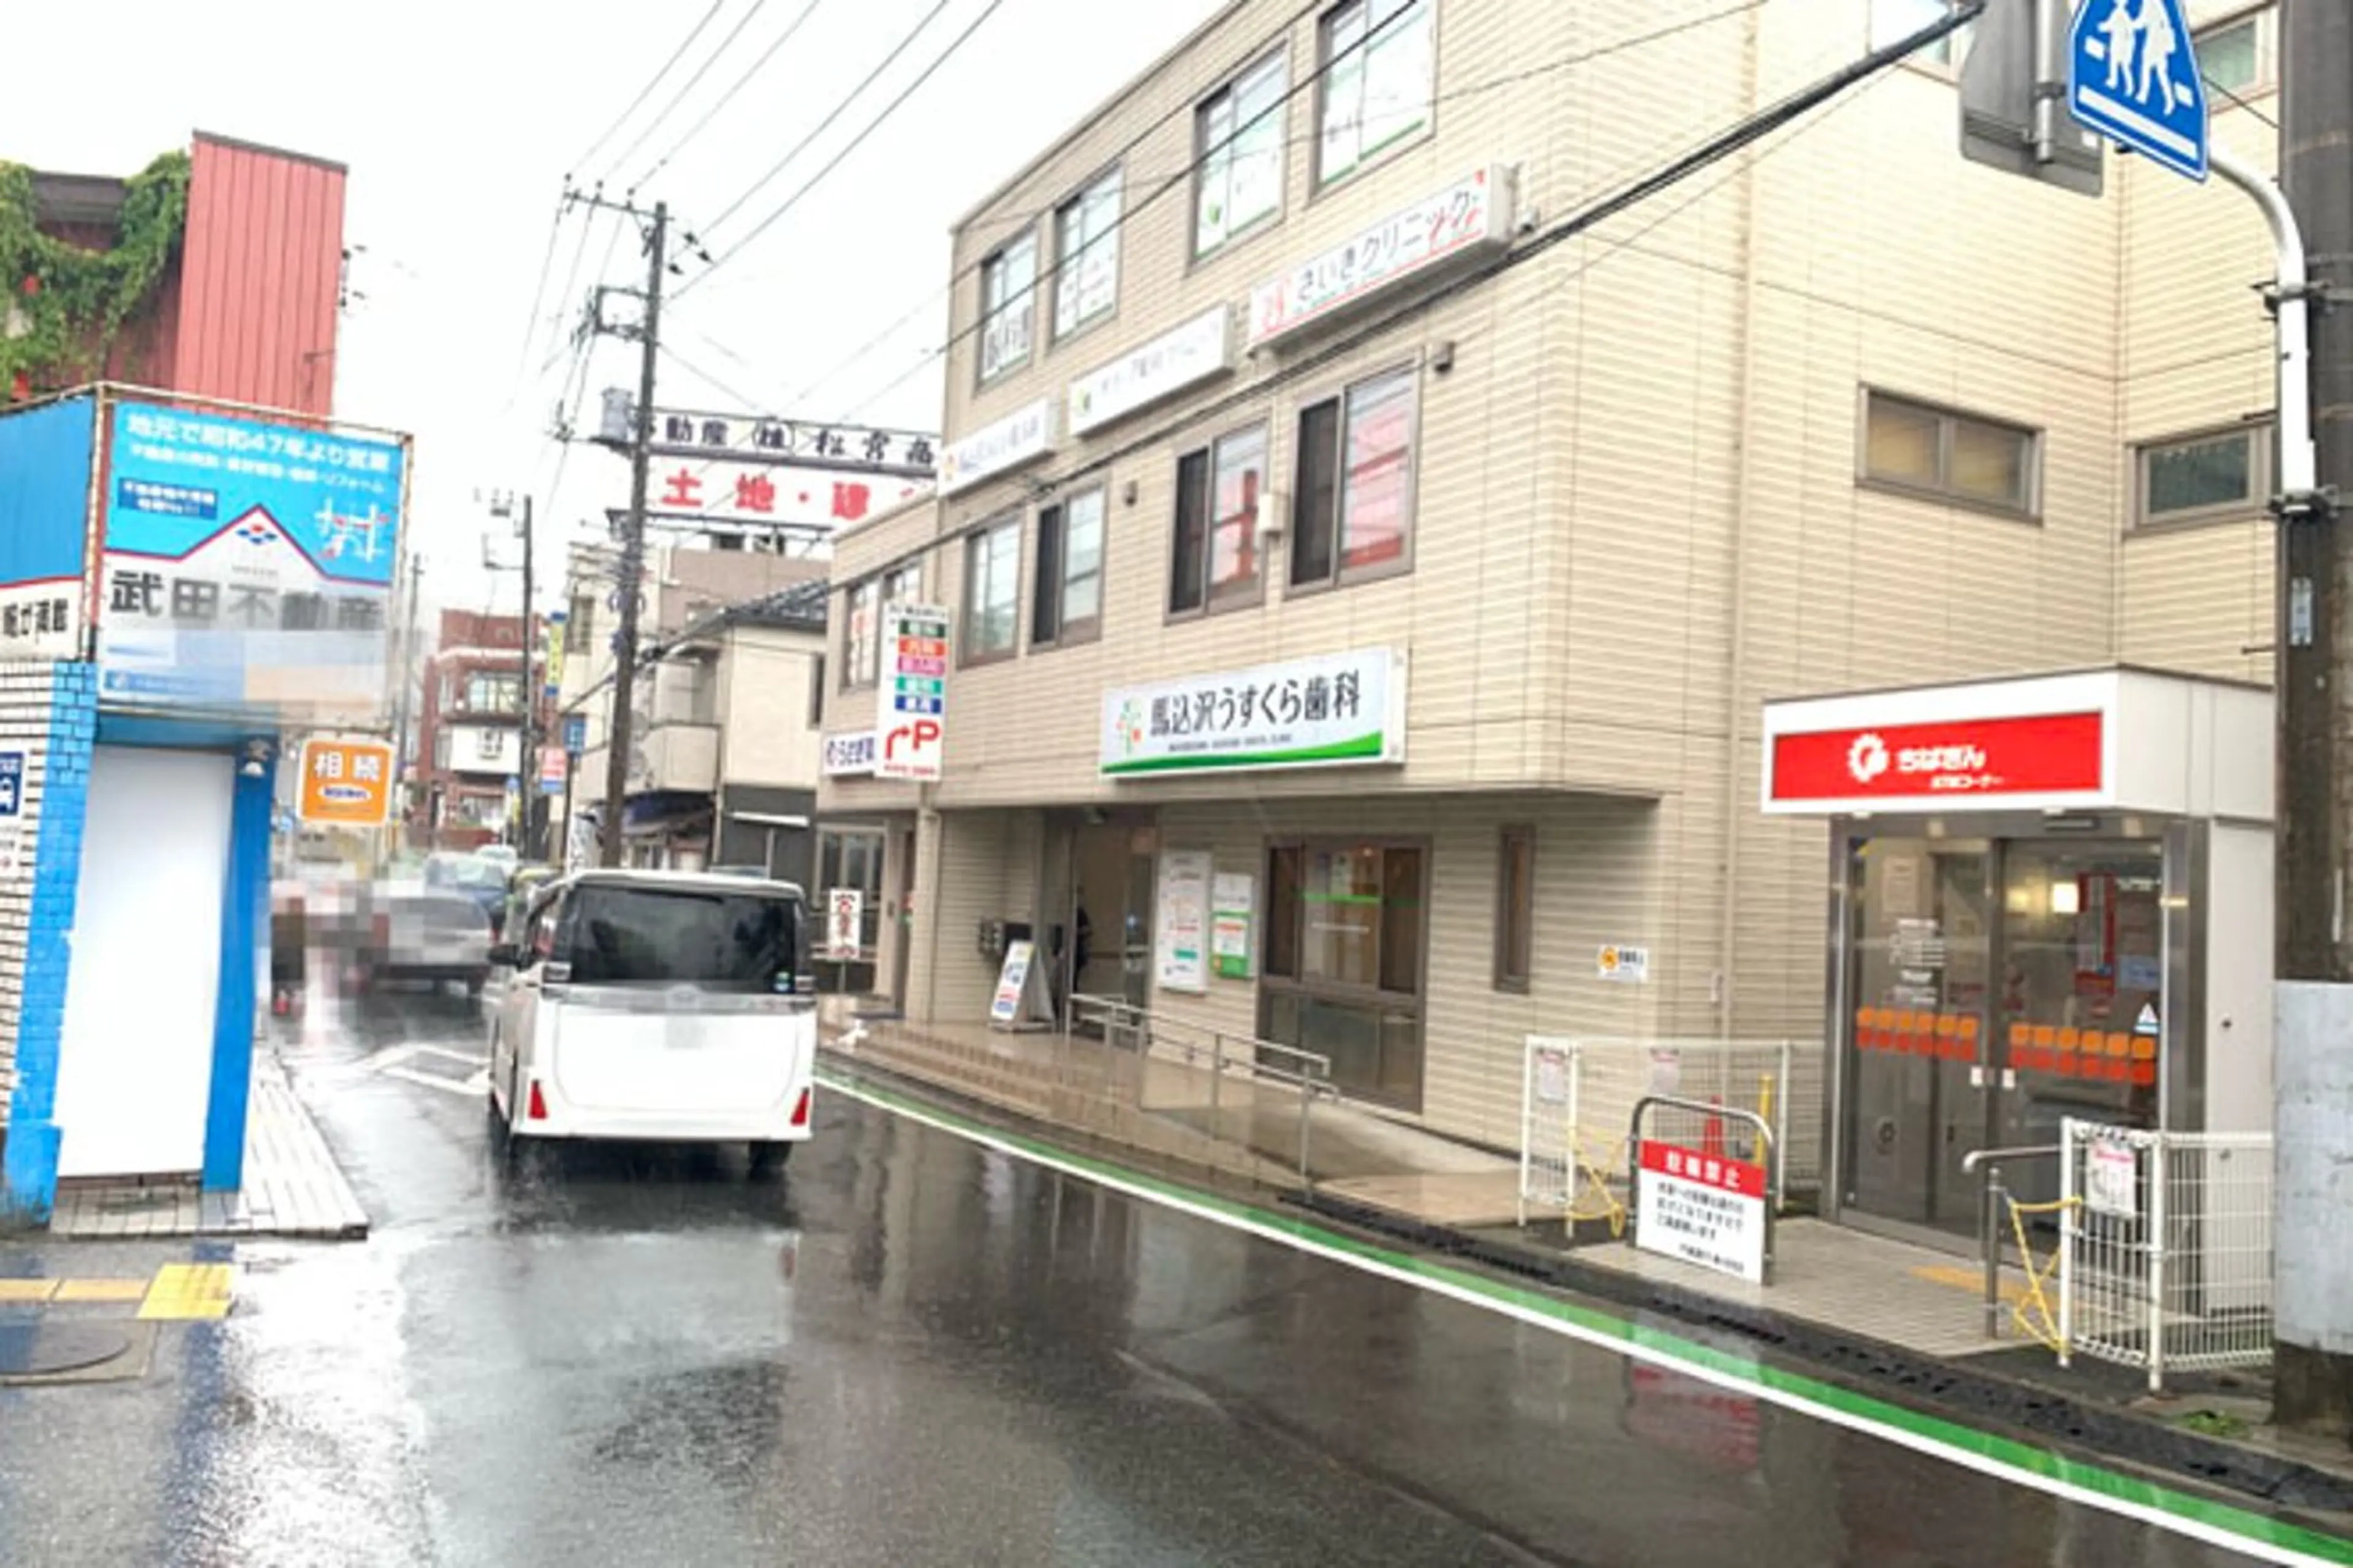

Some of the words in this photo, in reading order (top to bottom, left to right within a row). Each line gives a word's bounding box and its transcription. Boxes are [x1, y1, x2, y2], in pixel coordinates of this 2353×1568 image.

[1150, 669, 1360, 737] 馬込沢うすくら歯科
[911, 720, 941, 751] P
[1897, 745, 1987, 773] ちばぎん
